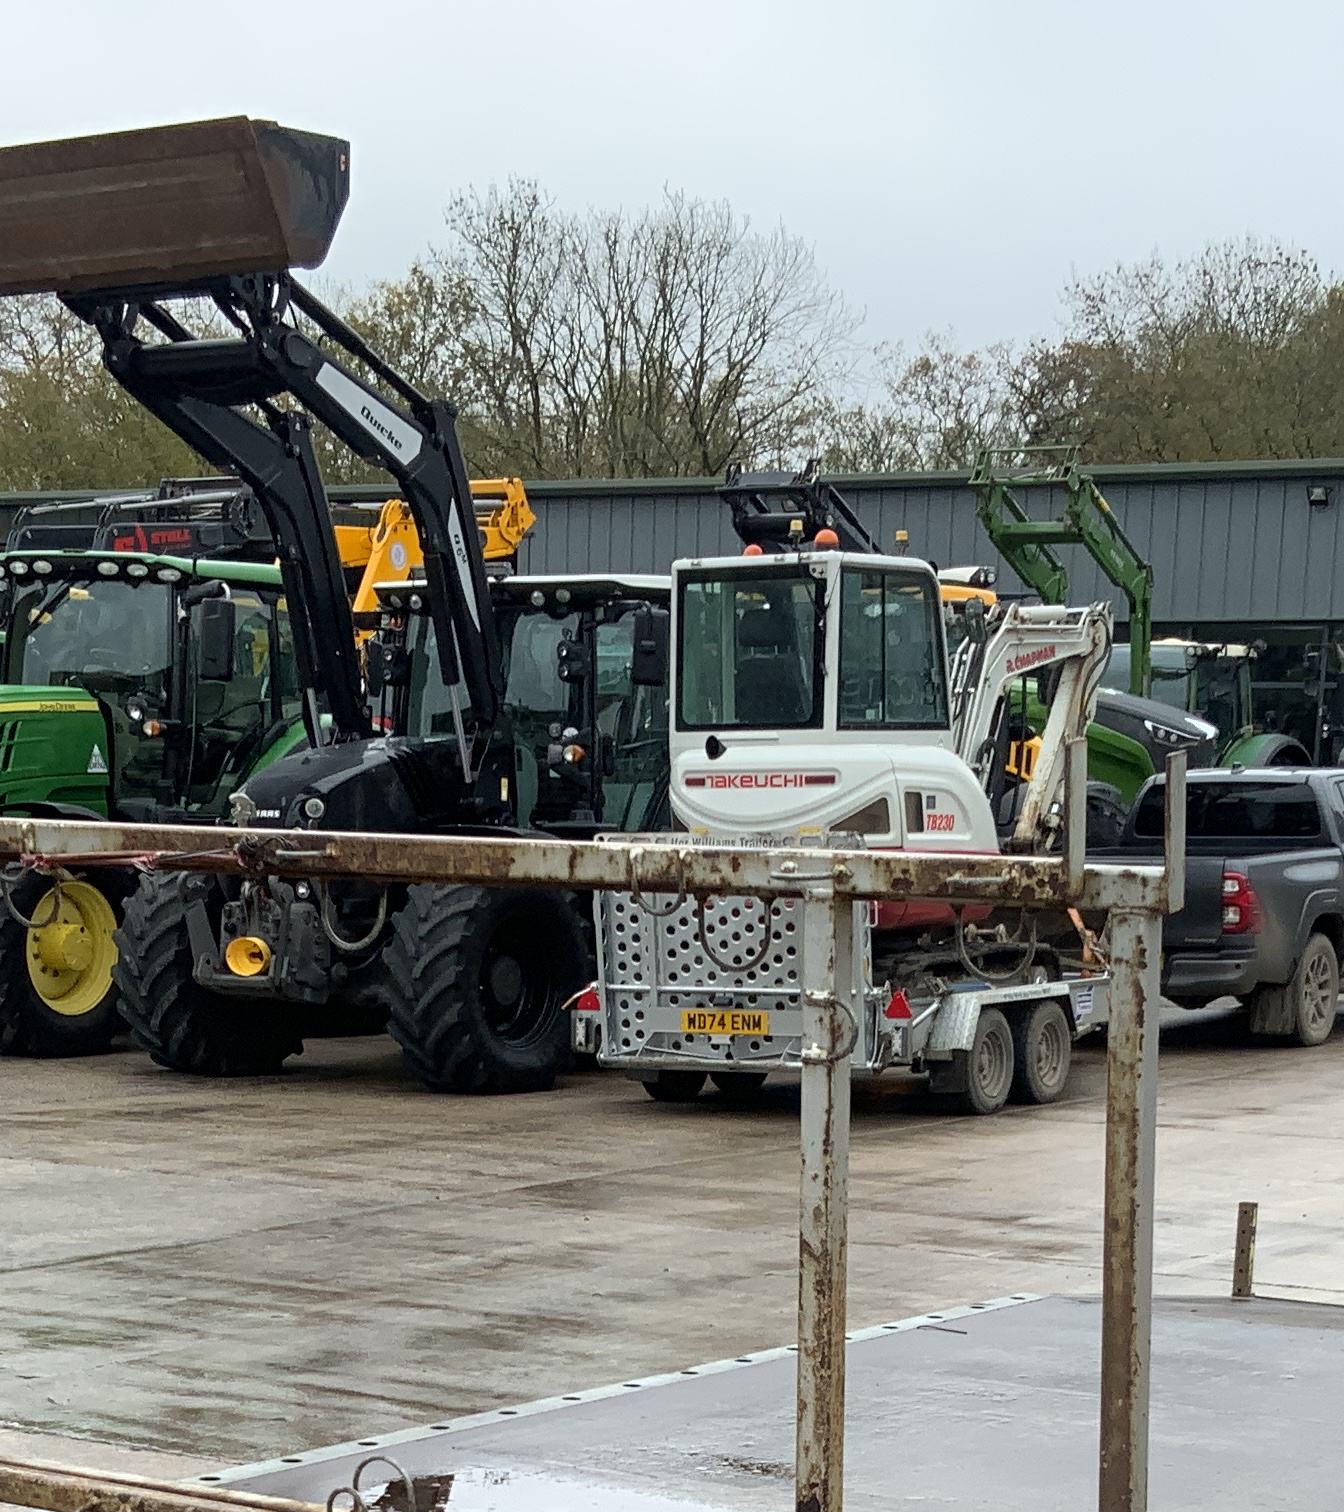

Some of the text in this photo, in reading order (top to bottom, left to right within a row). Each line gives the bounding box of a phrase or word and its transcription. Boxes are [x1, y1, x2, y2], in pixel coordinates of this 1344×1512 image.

[361, 405, 402, 450] Quicke
[706, 774, 804, 788] TAKEUCHI
[926, 814, 956, 832] TB230
[687, 1012, 762, 1032] WD74 ENM
